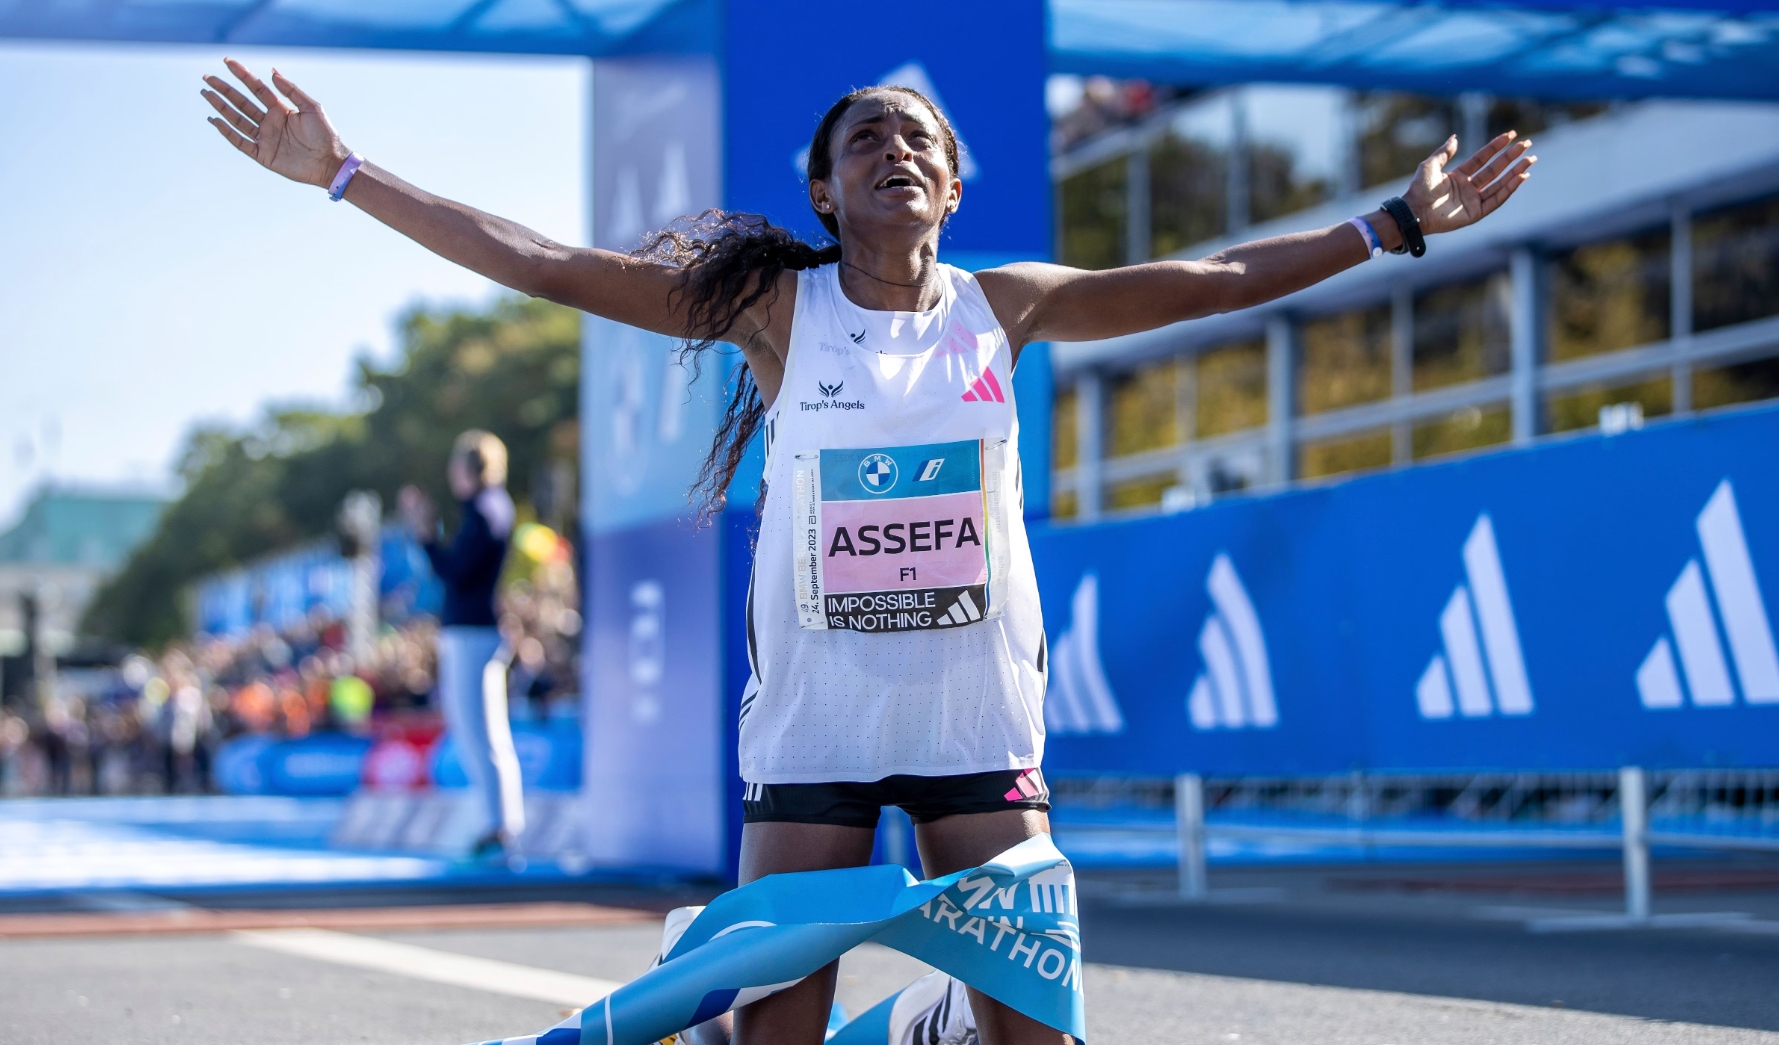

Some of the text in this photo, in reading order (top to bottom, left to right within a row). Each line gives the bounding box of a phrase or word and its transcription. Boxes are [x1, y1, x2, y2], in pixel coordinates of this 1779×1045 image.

[800, 400, 865, 412] Tirop's Angels
[808, 528, 817, 552] 2023
[828, 516, 981, 558] ASSEFA
[808, 553, 819, 601] September
[900, 567, 917, 582] F1
[798, 574, 808, 600] BMW
[828, 592, 936, 613] IMPOSSIBLE
[829, 611, 933, 630] IS NOTHING
